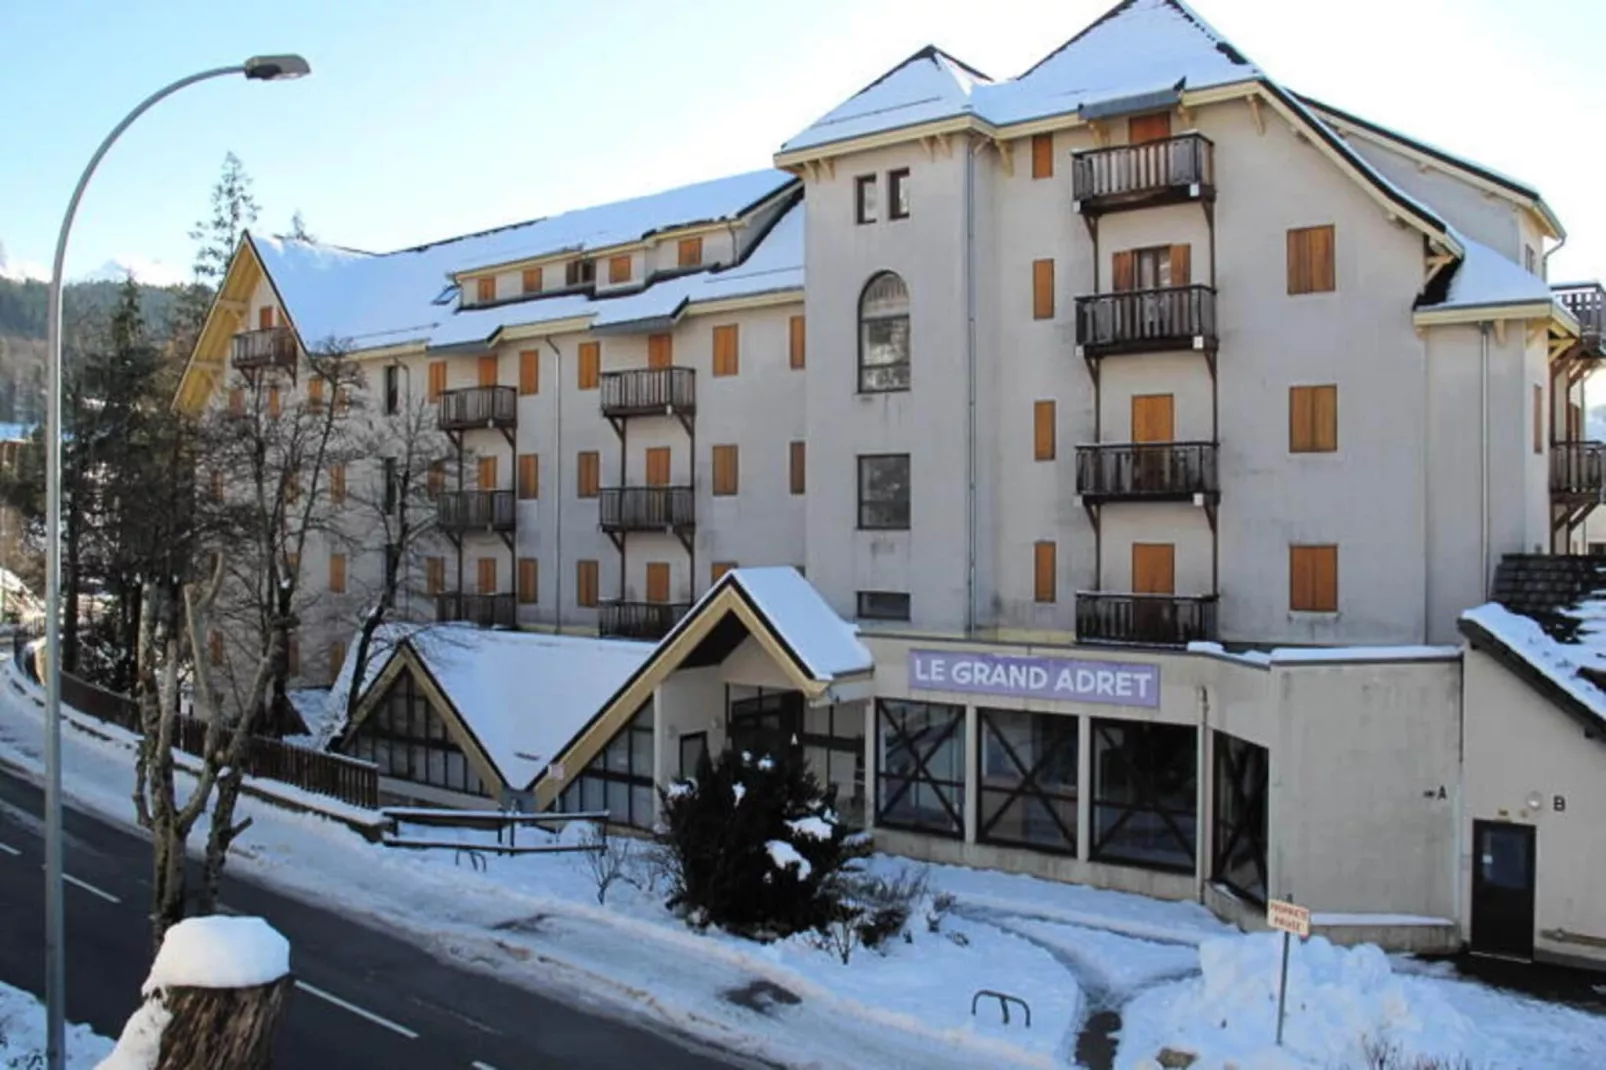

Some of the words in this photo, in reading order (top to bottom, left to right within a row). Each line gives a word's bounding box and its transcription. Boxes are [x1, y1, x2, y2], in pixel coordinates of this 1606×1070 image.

[915, 659, 946, 681] LE
[951, 661, 1048, 690] GRAND
[1054, 668, 1152, 698] ADRET
[1437, 784, 1447, 800] A
[1553, 795, 1566, 812] B
